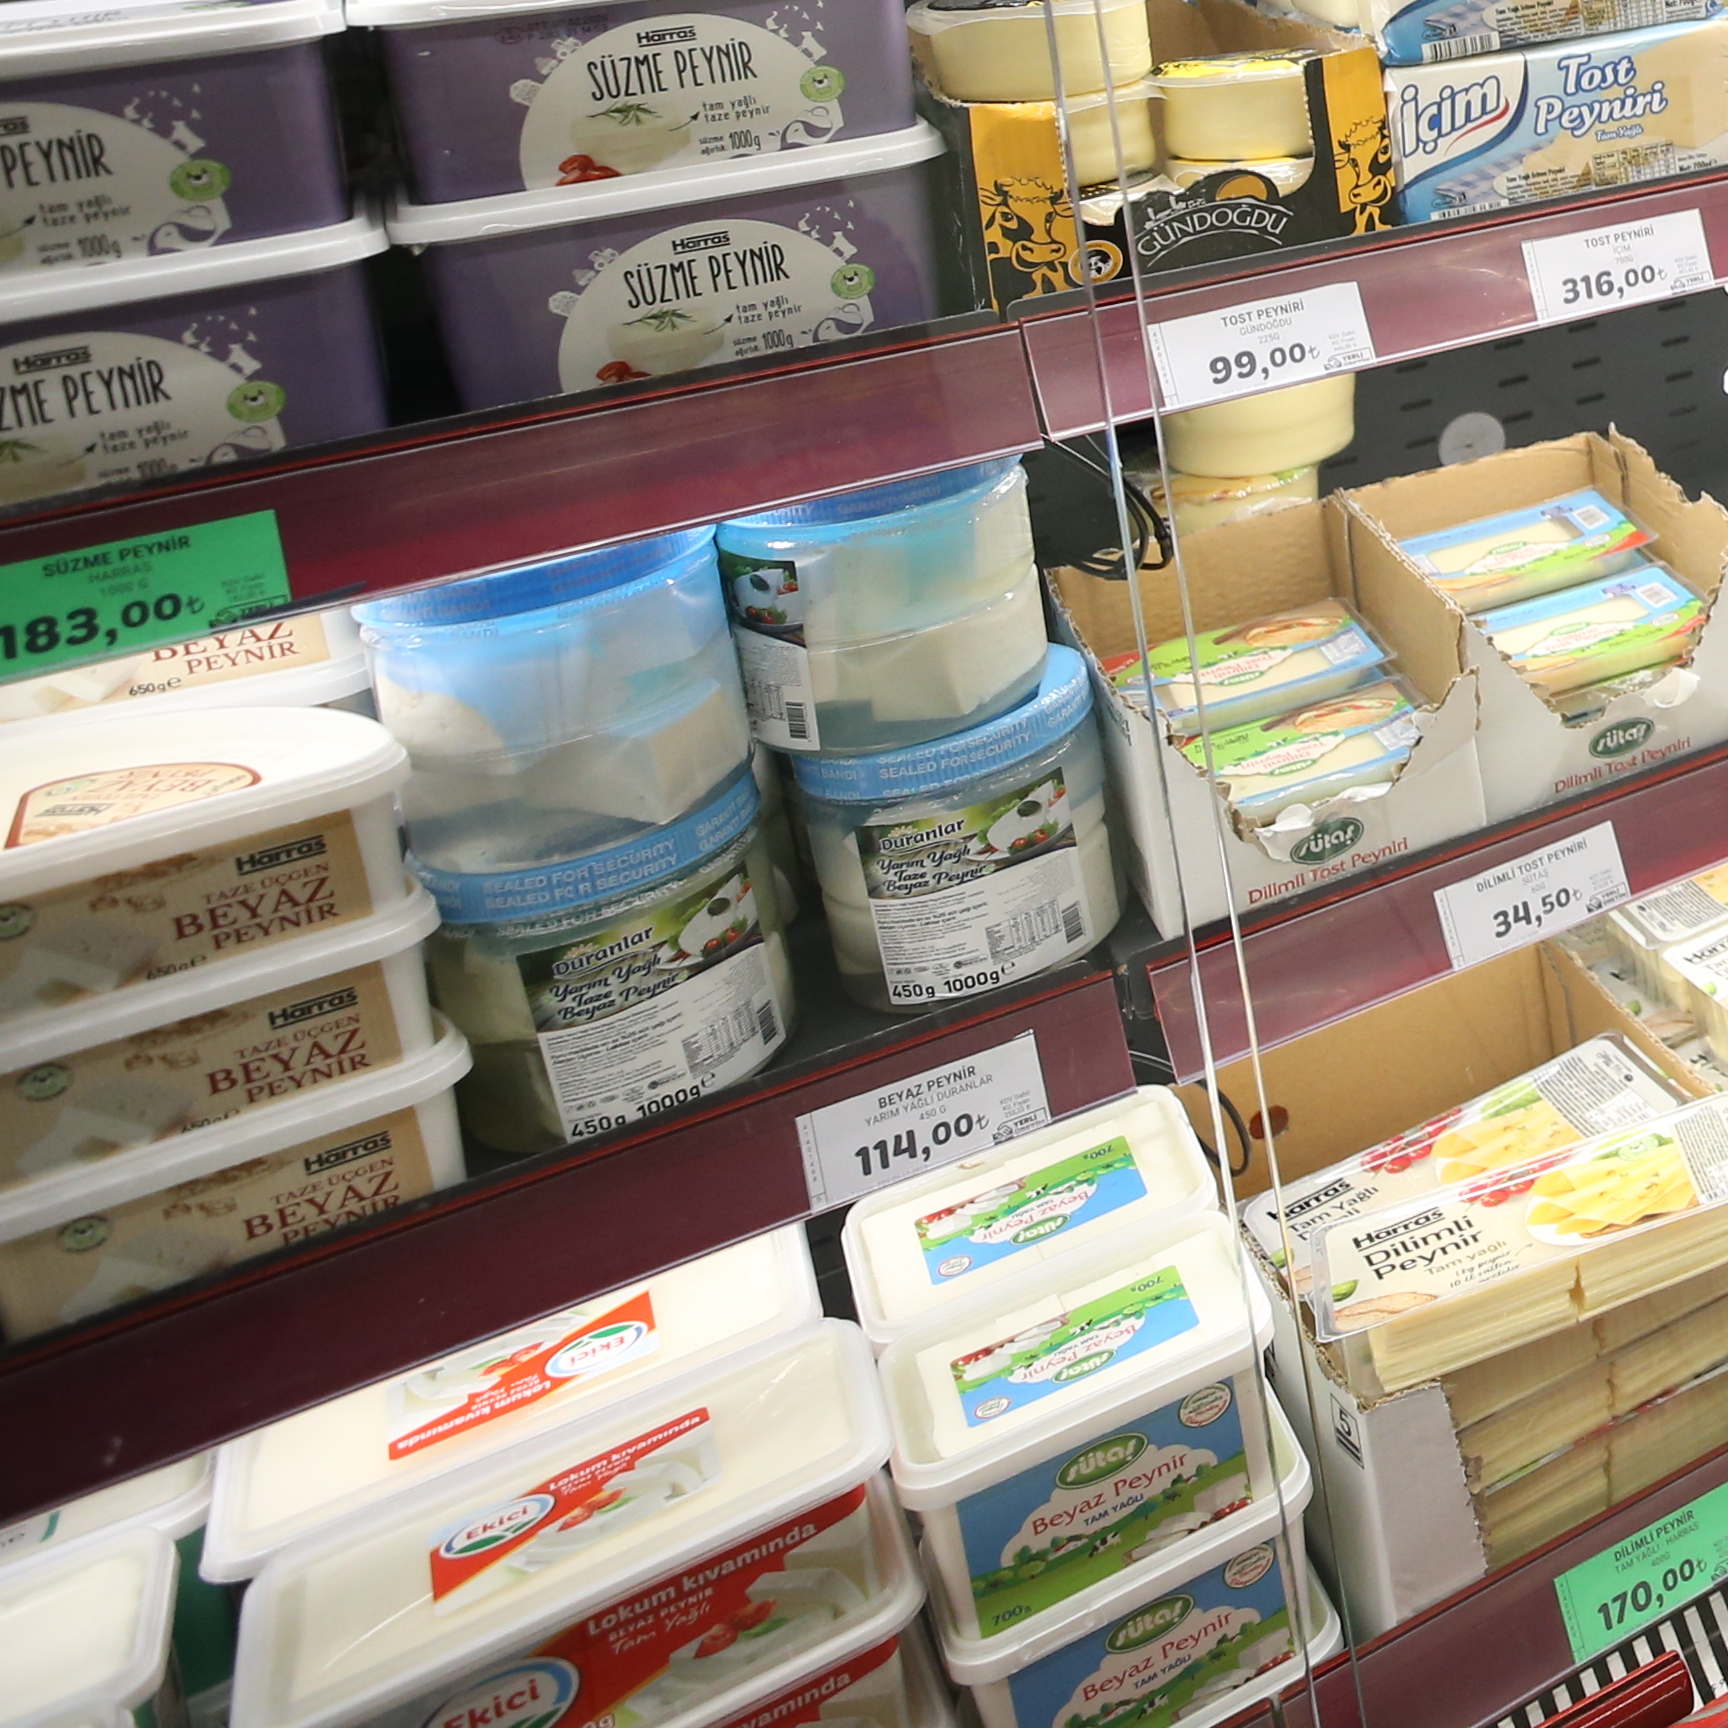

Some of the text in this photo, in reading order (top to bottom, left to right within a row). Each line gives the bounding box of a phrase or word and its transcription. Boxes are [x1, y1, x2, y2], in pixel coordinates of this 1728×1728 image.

[584, 36, 761, 104] SÜZME PEYNİR
[1559, 54, 1637, 96] Tost
[1400, 73, 1505, 159] İçim
[1135, 198, 1289, 258] GÜNDOĞDU
[622, 242, 792, 311] SÜZME PEYNİR
[1220, 298, 1305, 330] TOST PEYNİRİ
[63, 359, 173, 420] PEYNİR
[187, 640, 300, 675] PEYNİR
[876, 845, 971, 874] Yarım Yağlı
[881, 818, 965, 852] Duranlar
[202, 862, 331, 905] TAZE ÜÇGEN
[884, 863, 987, 896] Beyaz Peynir
[1246, 837, 1410, 906] Dilimli Tost Peyniri
[1475, 839, 1589, 894] DİLİMLİ TOST PEYNİRİ
[172, 875, 338, 943] BEYAZ
[212, 899, 340, 954] PEYNİR
[552, 925, 654, 974] Duranlar
[550, 955, 661, 1003] Yarım Yağlı
[557, 972, 681, 1021] Beyaz Peynir
[572, 989, 613, 1008] Taze
[891, 967, 1002, 1002] 450g 1000g
[206, 1027, 371, 1097] BEYAZ
[235, 1015, 361, 1061] TAZE ÜÇGEN
[636, 1085, 701, 1119] 1000g
[865, 1074, 993, 1127] YARIM YAĞLI DURANLAR
[878, 1066, 976, 1109] BEYAZ PEYNİR
[243, 1171, 402, 1242] BEYAZ
[1360, 1214, 1476, 1276] Dilimli
[1373, 1229, 1484, 1283] Peynir
[1031, 1449, 1191, 1541] Beyaz Peynir
[1082, 1493, 1145, 1529] TAM YAĞLI
[1613, 1509, 1695, 1562] DİLİMLİ PEYNİR
[587, 1522, 818, 1636] Lokum kıvamında
[1082, 1609, 1234, 1705] Beyaz Peynir
